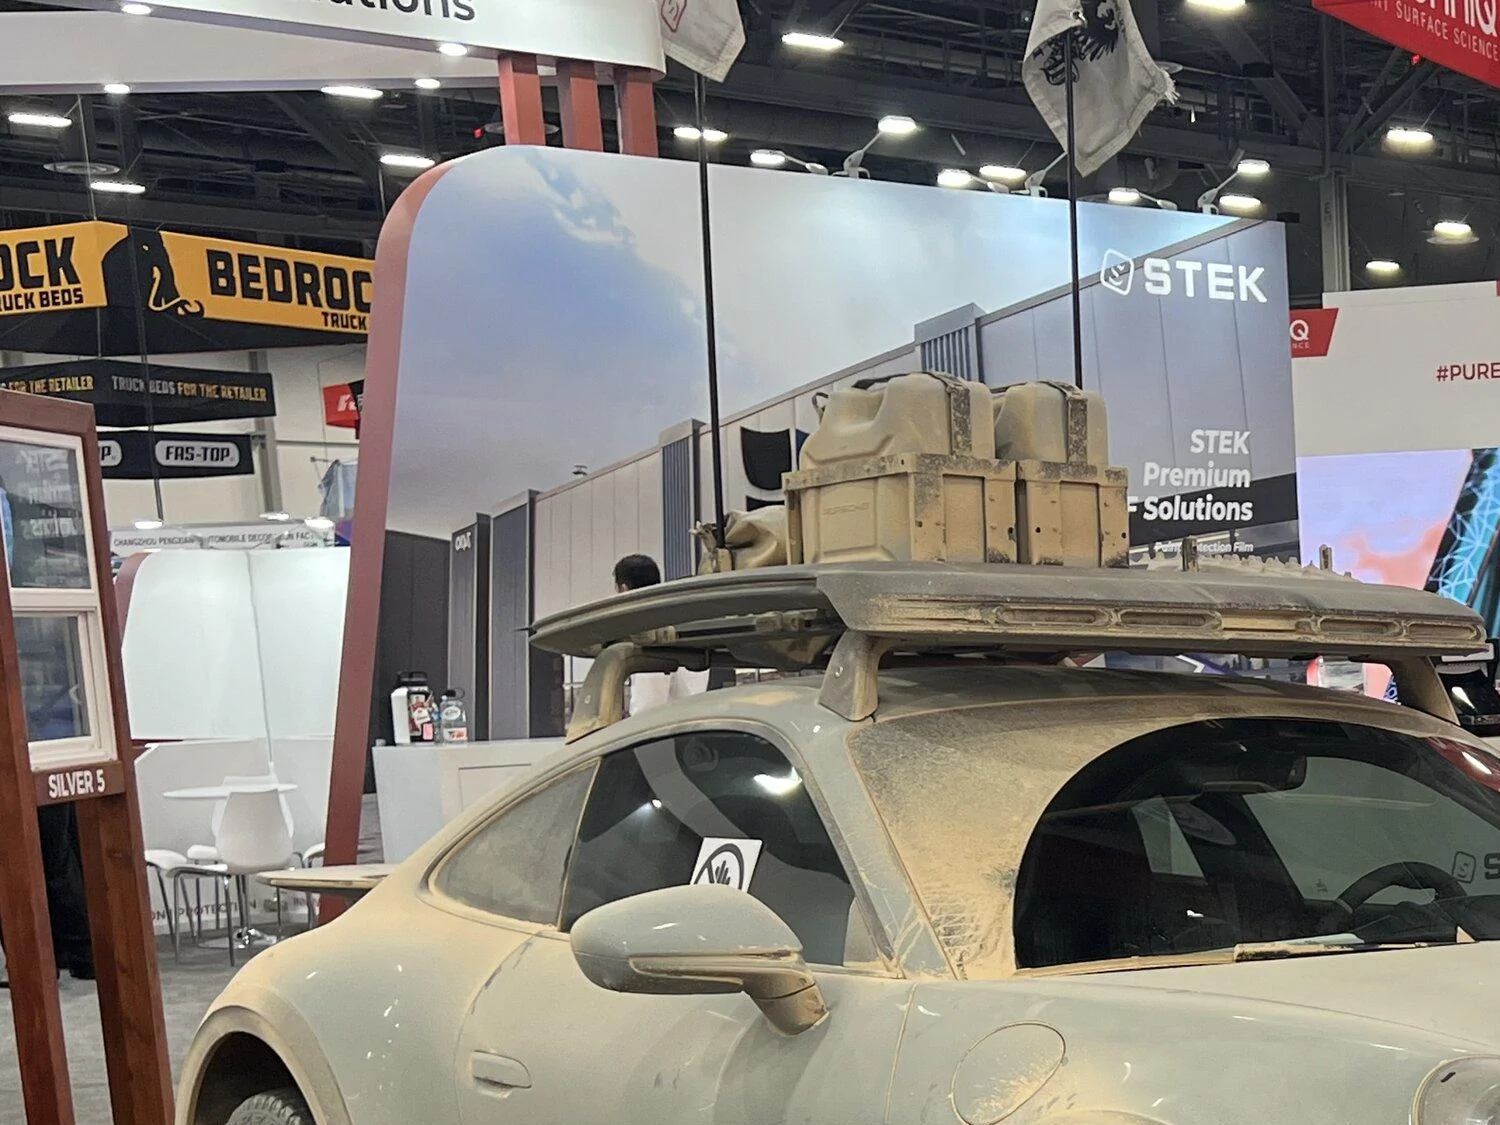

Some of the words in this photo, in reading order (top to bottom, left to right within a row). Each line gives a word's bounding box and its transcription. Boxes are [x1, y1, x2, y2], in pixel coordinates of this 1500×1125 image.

[1396, 1, 1449, 40] SURFACE
[1453, 28, 1499, 61] SCIENCE
[1143, 258, 1267, 303] STEK
[39, 288, 84, 308] BEDS
[321, 311, 367, 330] TRUCK
[49, 375, 94, 392] RETAILER
[112, 375, 144, 392] TRUCK
[150, 380, 175, 395] BEDS
[177, 384, 197, 397] FOR
[200, 385, 219, 398] THE
[222, 386, 267, 401] RETAILER
[166, 446, 230, 462] FAS-TOP
[1190, 429, 1251, 454] STEK
[1143, 460, 1251, 488] Premium
[1143, 493, 1253, 521] Solutions
[48, 770, 94, 798] SILVER
[96, 768, 105, 792] 5
